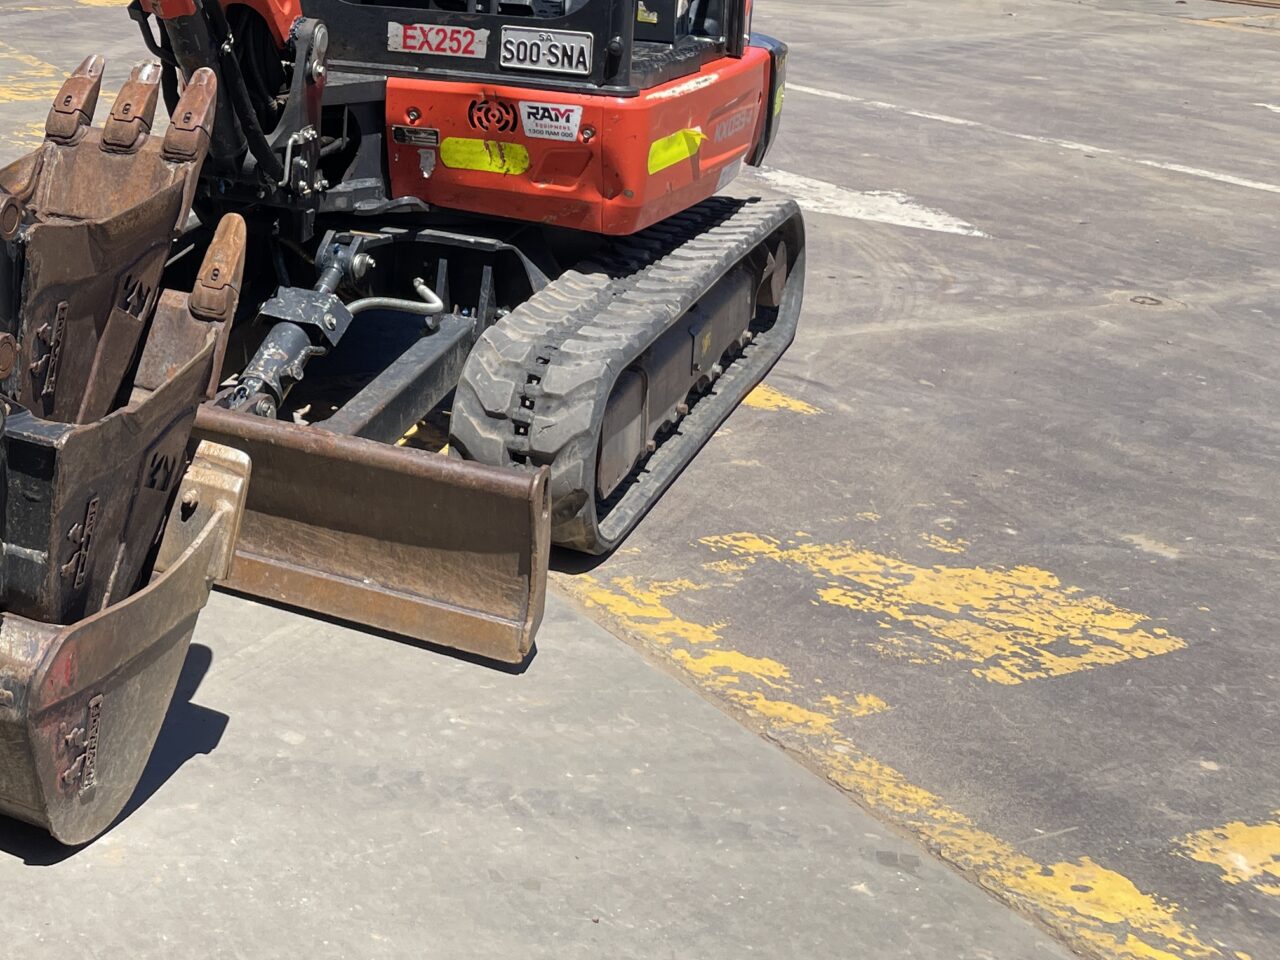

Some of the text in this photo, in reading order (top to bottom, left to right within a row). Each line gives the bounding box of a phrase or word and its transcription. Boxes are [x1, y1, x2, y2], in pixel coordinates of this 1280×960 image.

[402, 25, 476, 55] EX252
[538, 33, 553, 42] SA
[527, 105, 574, 123] RAM
